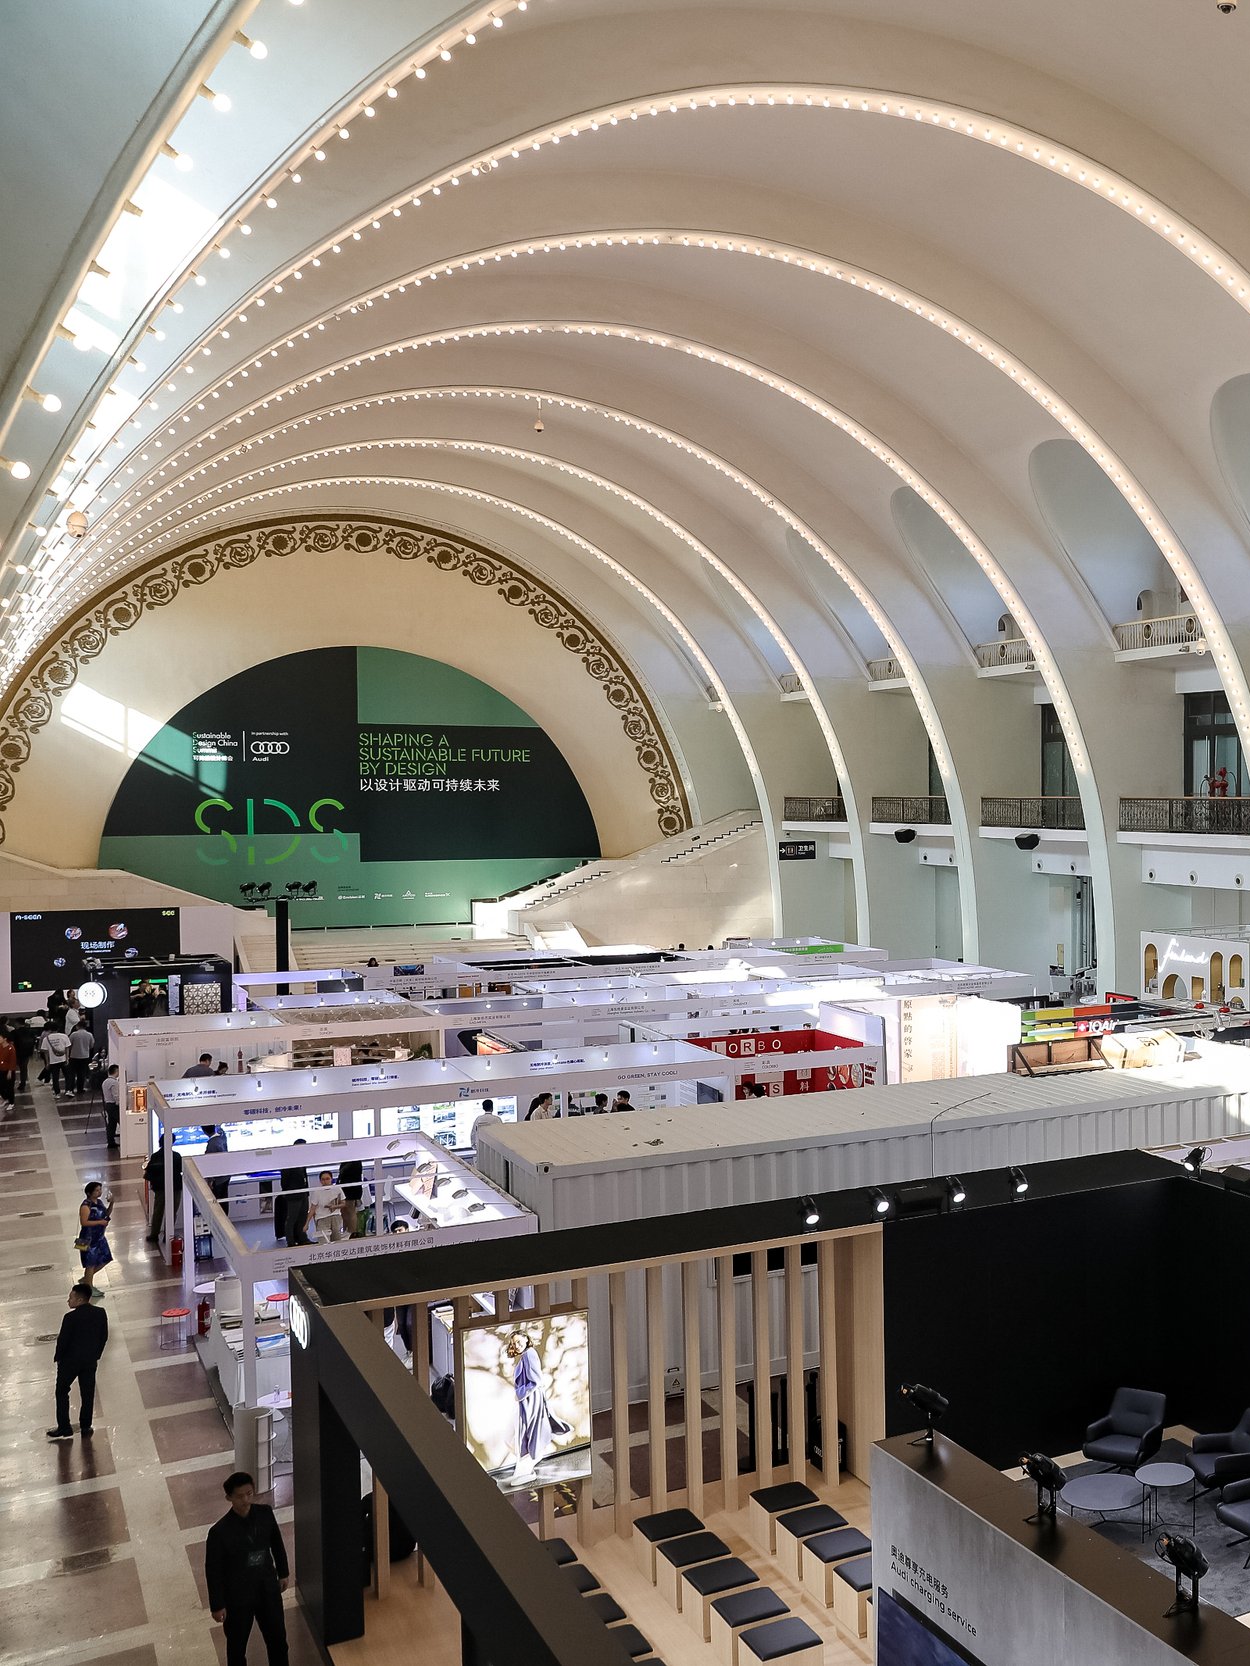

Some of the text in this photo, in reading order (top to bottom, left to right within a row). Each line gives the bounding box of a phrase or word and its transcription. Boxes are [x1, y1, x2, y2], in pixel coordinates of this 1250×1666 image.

[192, 731, 231, 739] Sustainable
[359, 732, 449, 746] SHAPING A
[192, 739, 216, 747] Design
[359, 747, 531, 762] SUSTAINABLE FUTURE
[359, 762, 447, 776] BY DESIGN
[360, 778, 500, 792] 以设计驱动可持续未来
[80, 941, 115, 950] 现场制作
[891, 1561, 977, 1637] Audi charging service
